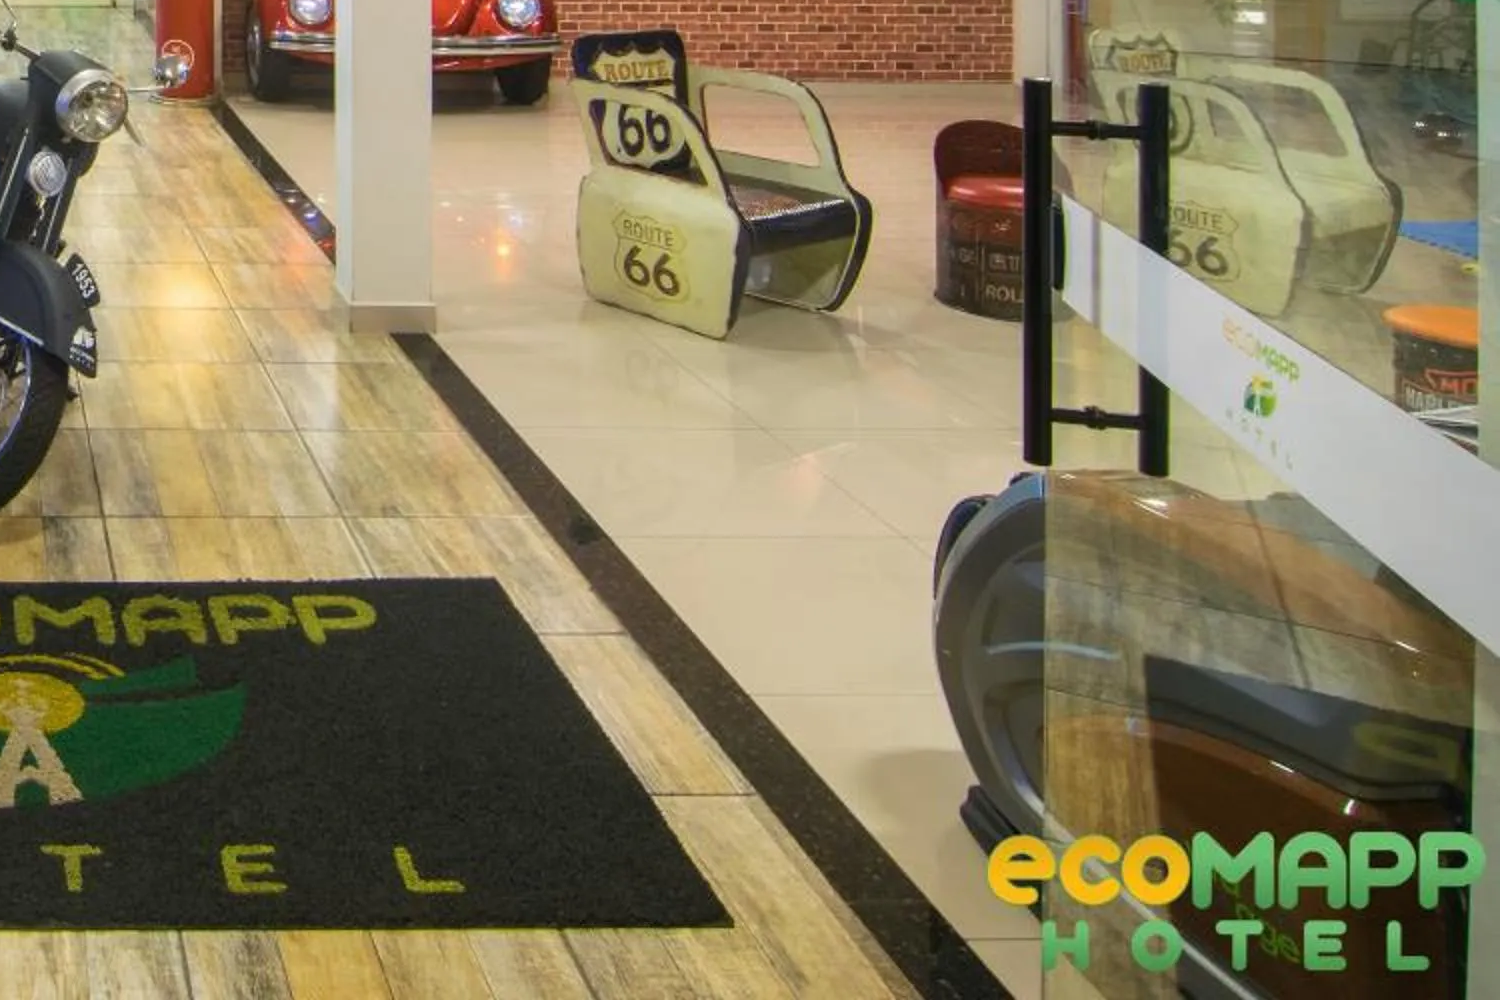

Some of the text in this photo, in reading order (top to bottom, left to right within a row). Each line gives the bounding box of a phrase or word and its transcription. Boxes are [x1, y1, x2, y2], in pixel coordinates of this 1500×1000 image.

[603, 60, 671, 82] ROUTE
[618, 104, 672, 157] 66
[623, 219, 674, 247] ROUTE
[1169, 206, 1224, 231] OUTE
[72, 262, 96, 300] 1953
[623, 245, 680, 297] 66
